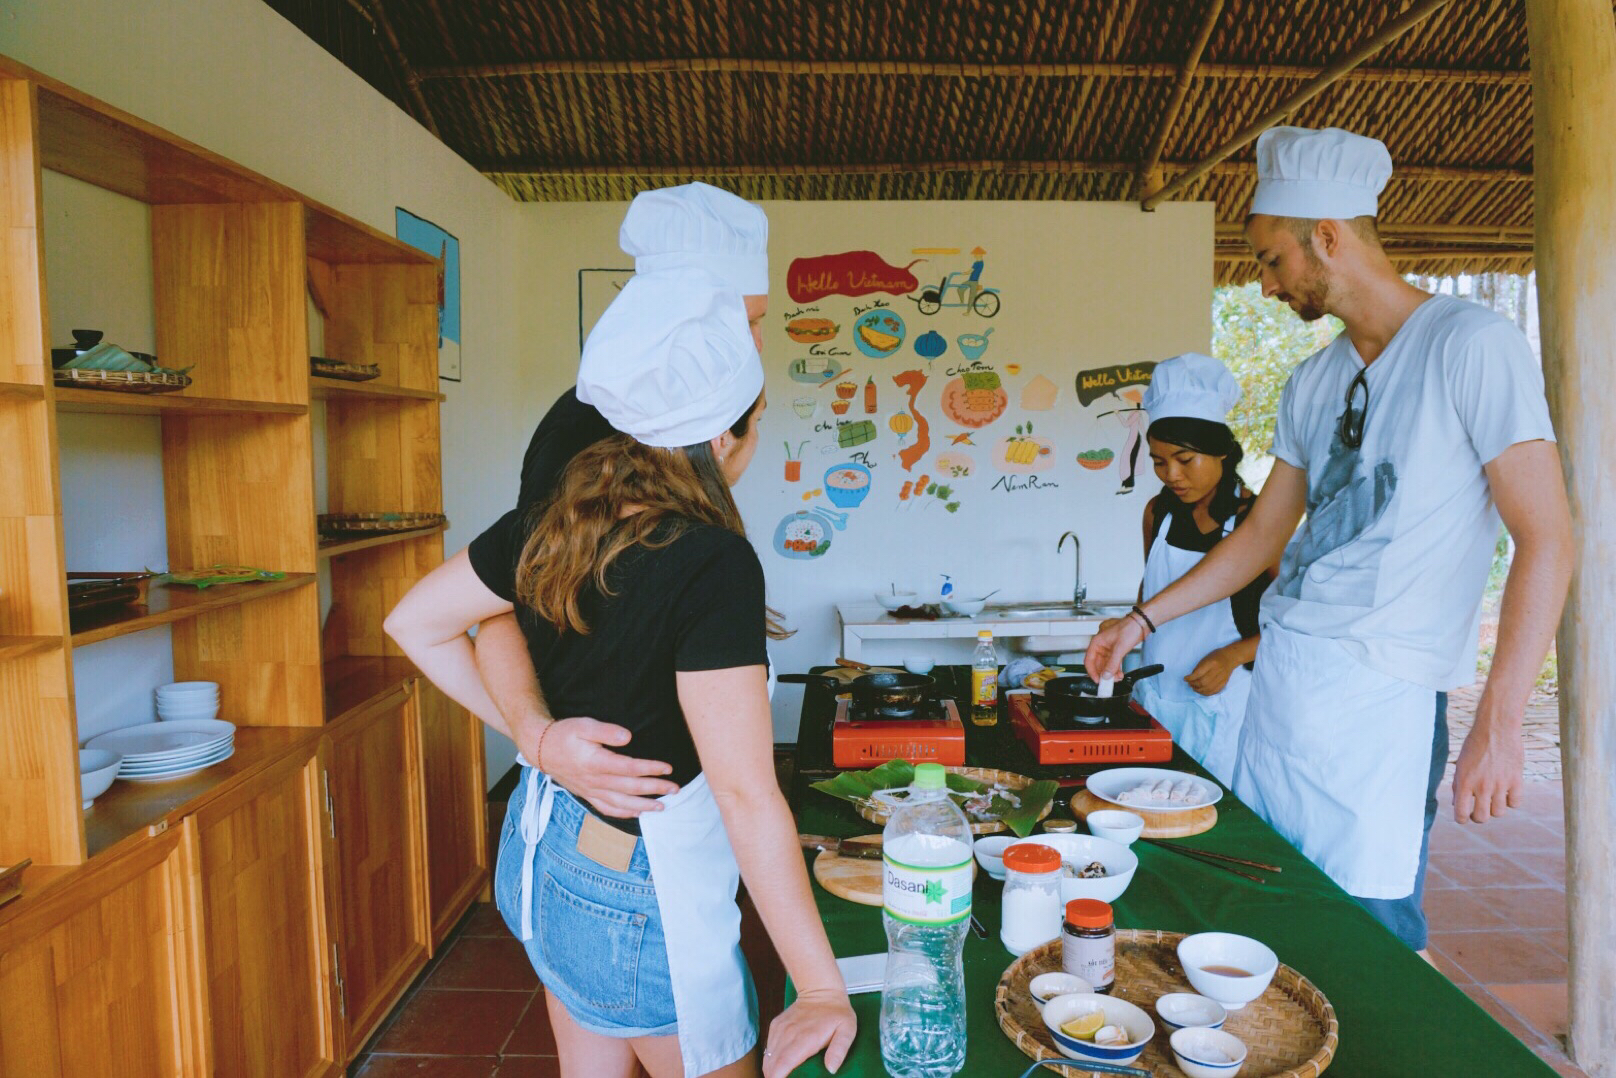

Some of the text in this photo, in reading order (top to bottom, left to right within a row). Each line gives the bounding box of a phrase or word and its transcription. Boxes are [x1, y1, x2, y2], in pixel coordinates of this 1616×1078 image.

[797, 271, 915, 295] Hello Vietnam
[1082, 372, 1116, 390] Hello
[991, 475, 1028, 493] Nem
[887, 870, 929, 894] Dasani
